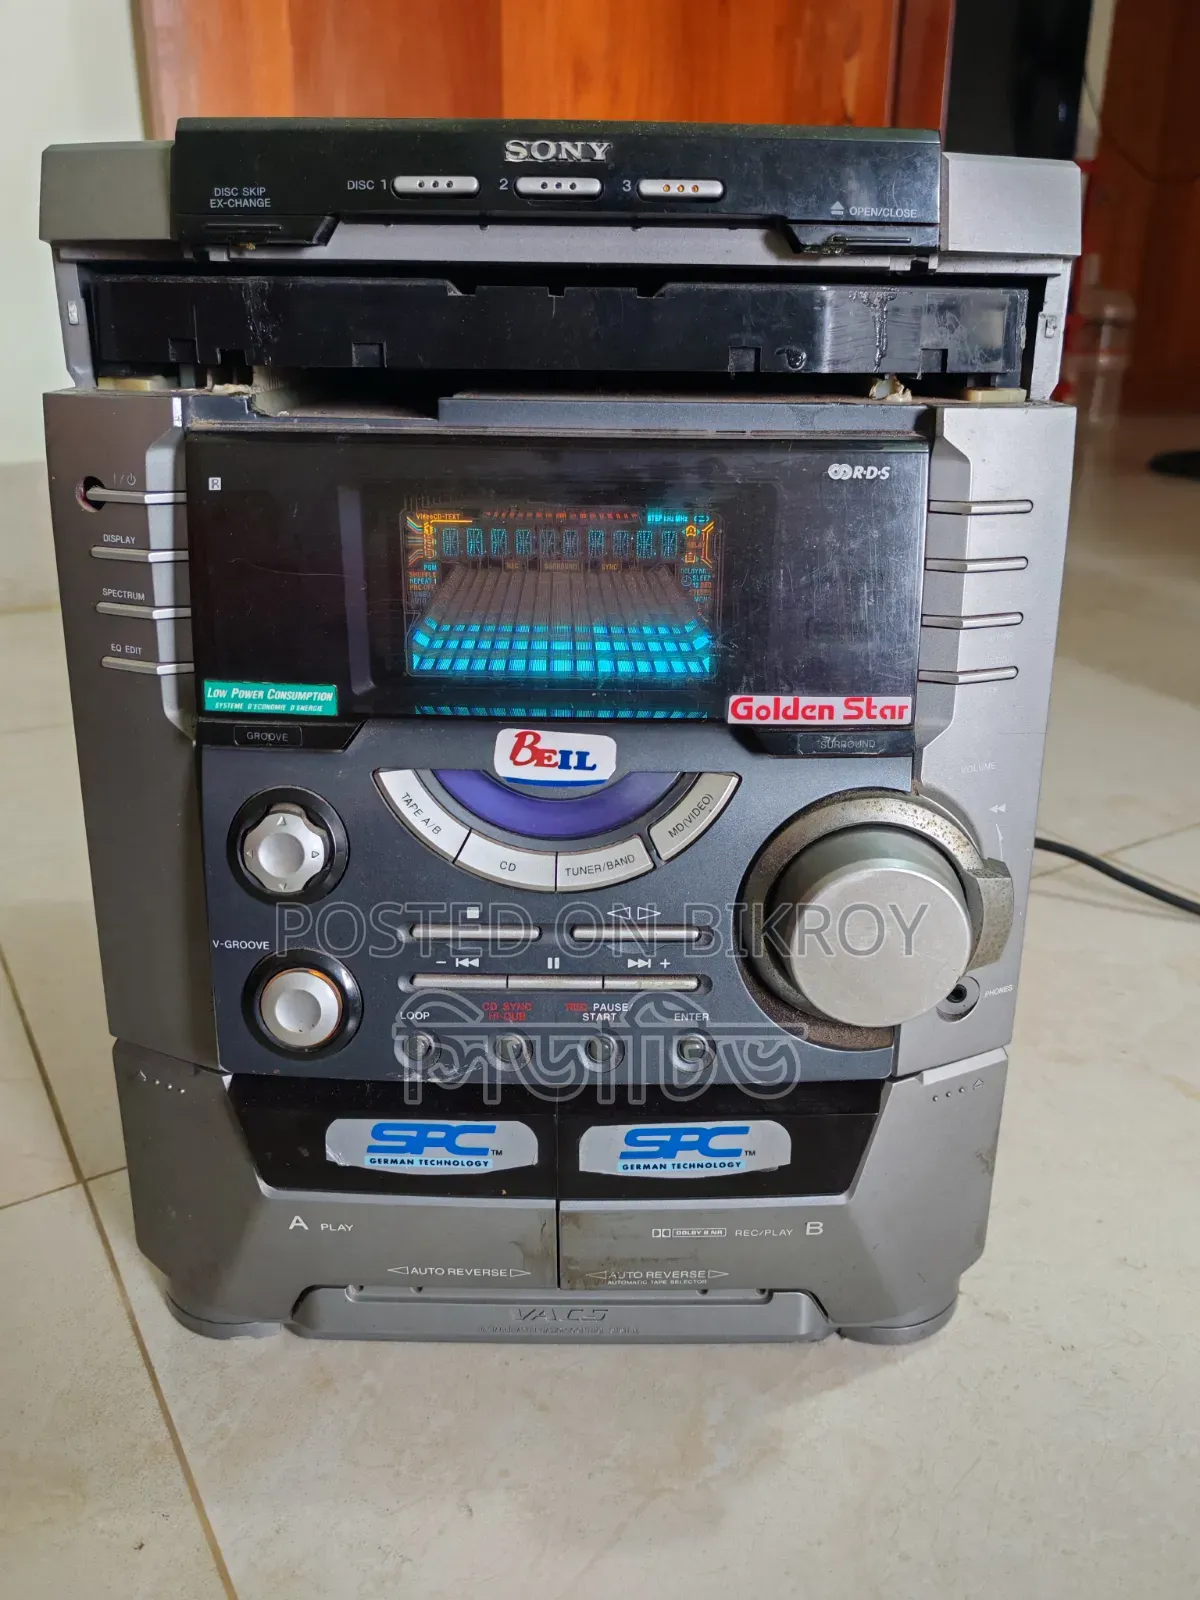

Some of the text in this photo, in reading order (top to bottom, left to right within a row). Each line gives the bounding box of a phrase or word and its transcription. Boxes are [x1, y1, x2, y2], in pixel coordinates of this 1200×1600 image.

[505, 140, 611, 163] SONY
[347, 178, 388, 191] DISC 1
[499, 179, 509, 191] 2
[622, 179, 632, 192] 3
[213, 186, 267, 198] DISC SKIP
[209, 197, 272, 209] EX-CHANGE
[848, 205, 918, 219] OPEN/CLOSE
[103, 533, 136, 545] DISPLAY
[102, 587, 146, 601] SPECTRUM
[110, 643, 142, 655] EQ EDIT
[730, 696, 909, 721] Golden Star
[246, 731, 289, 742] GROOVE
[820, 739, 876, 749] SURROUND
[960, 762, 997, 774] VOLUME
[401, 792, 443, 836] TAPE A/B
[668, 792, 714, 839] MD(VIDEO)
[499, 861, 517, 872] CD
[564, 854, 636, 877] TUNER/BAND
[212, 940, 270, 951] V-GROOVE
[984, 984, 1013, 998] PHONES
[482, 1002, 533, 1011] CD SYNC
[400, 1011, 430, 1020] LOOP
[488, 1012, 526, 1021] HI-DUB
[582, 1013, 617, 1022] START
[674, 1012, 710, 1022] ENTER
[369, 1157, 489, 1167] GERMAN TECHNOLOGY
[622, 1161, 742, 1171] GERMAN TECHNOLOGY
[288, 1215, 354, 1232] A PLAY
[734, 1221, 824, 1237] REC/PLAY B
[410, 1266, 508, 1277] AUTO REVERSE
[608, 1269, 707, 1279] AUTO REVERSE
